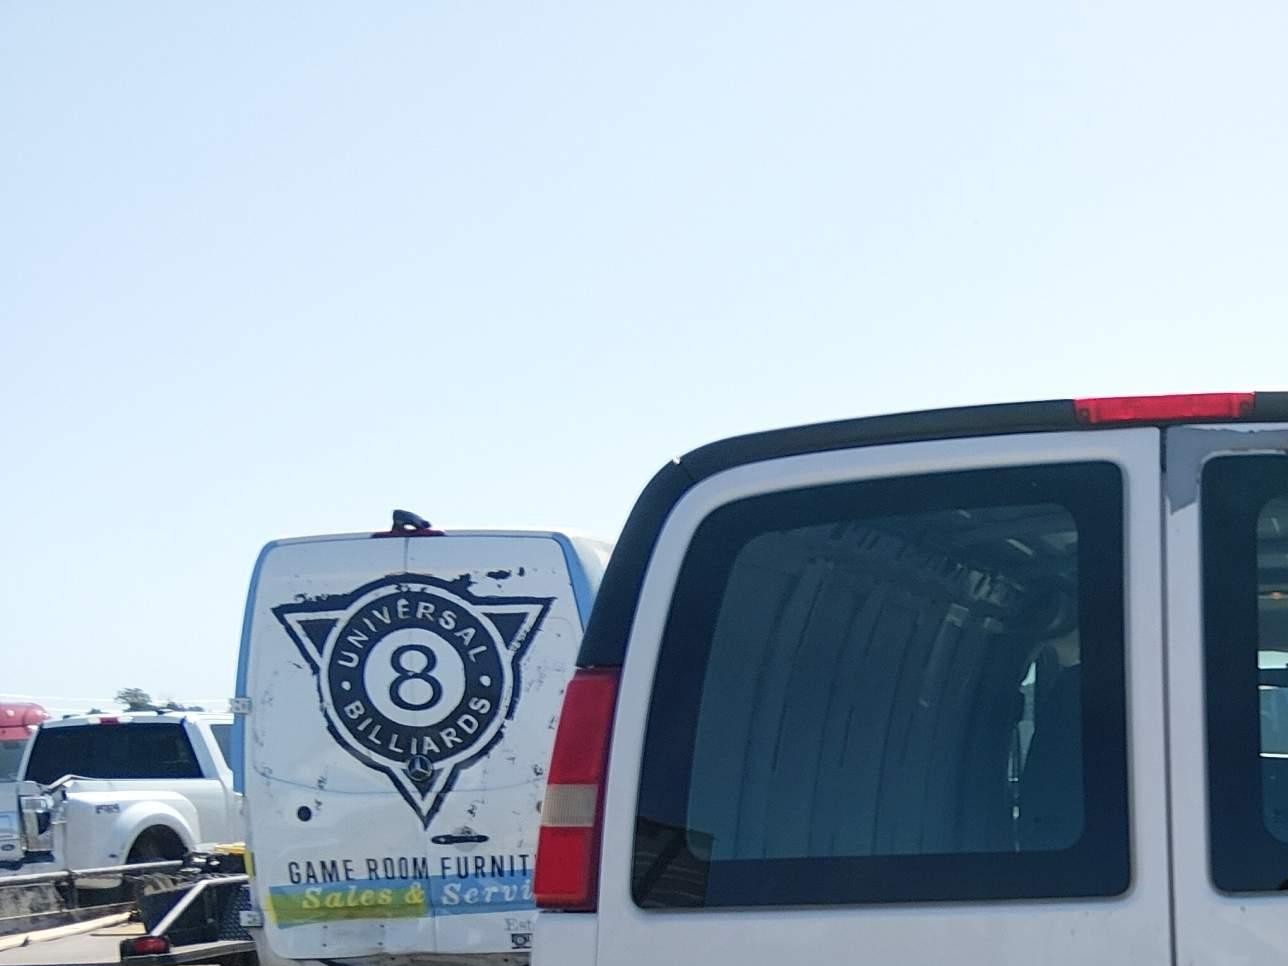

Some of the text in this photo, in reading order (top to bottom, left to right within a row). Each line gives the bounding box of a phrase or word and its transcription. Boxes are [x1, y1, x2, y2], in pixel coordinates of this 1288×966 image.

[337, 598, 487, 668] UNIVERSAL
[388, 644, 443, 711] 8
[344, 696, 491, 756] BILLIARDS
[288, 854, 537, 884] GAME ROOM FURNIT
[302, 885, 393, 909] Sales
[404, 882, 425, 904] &
